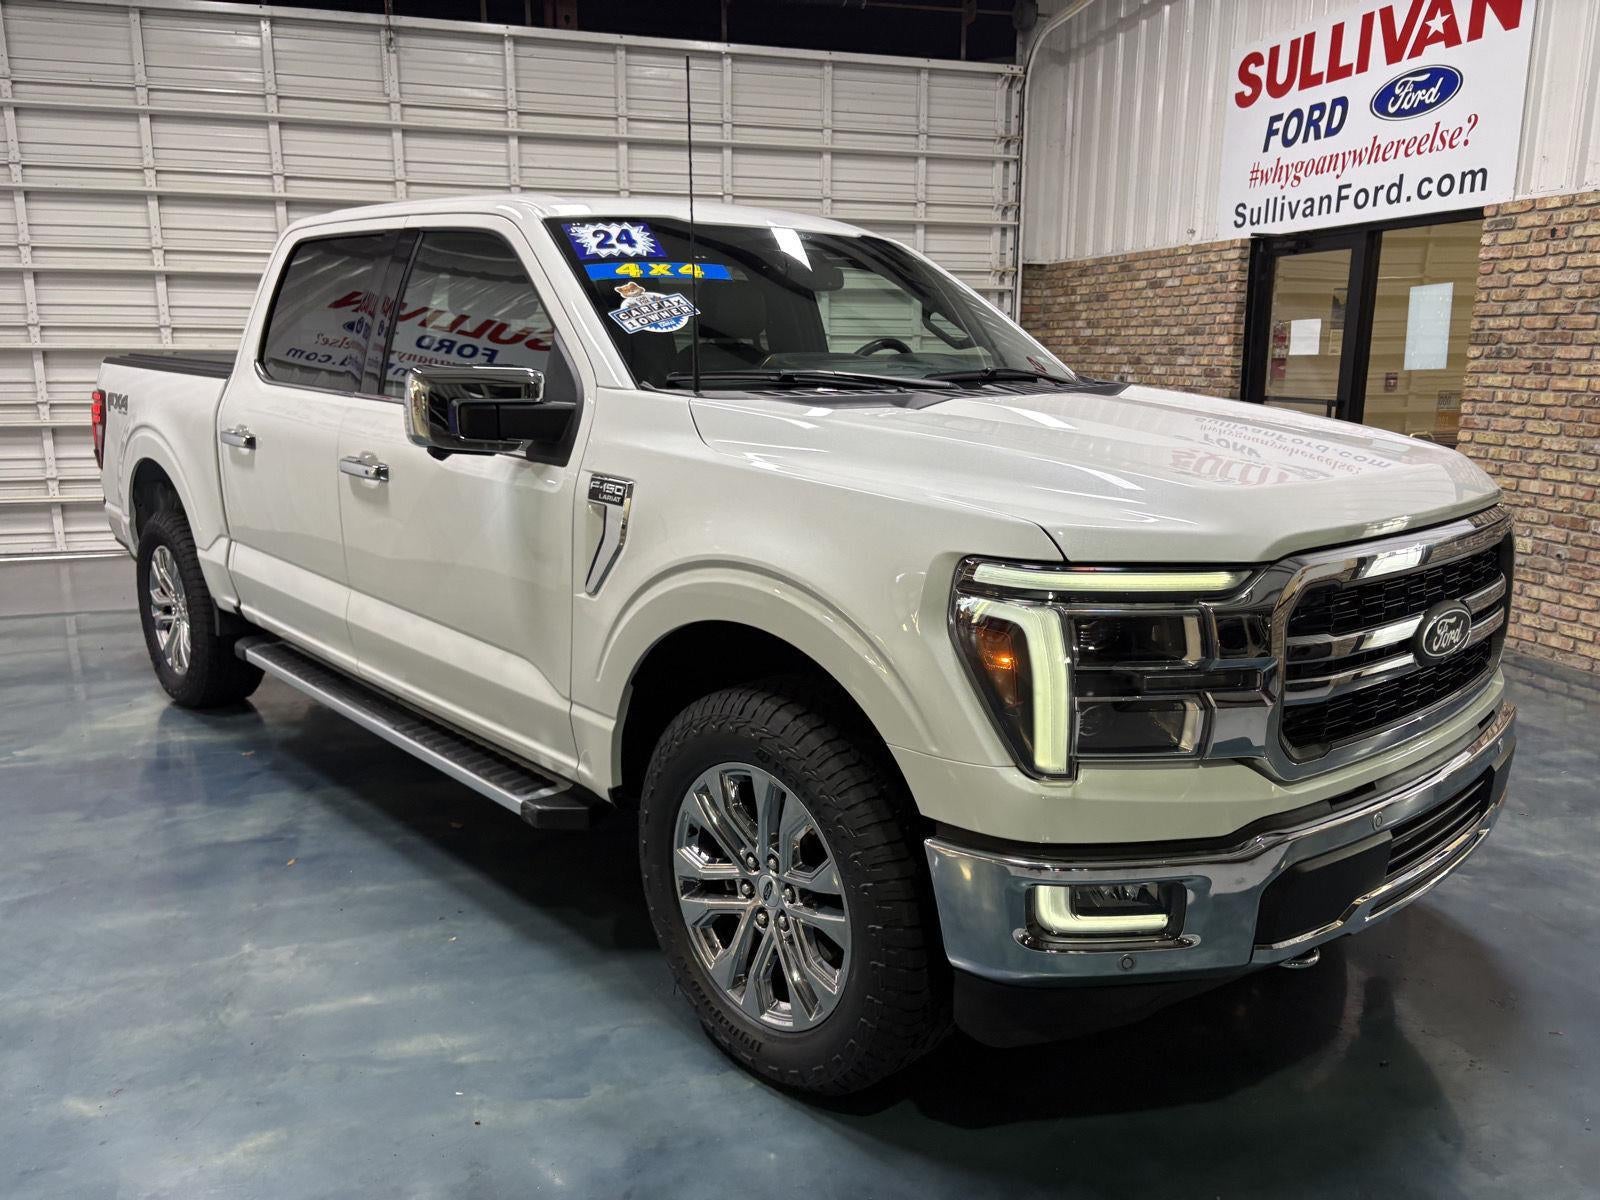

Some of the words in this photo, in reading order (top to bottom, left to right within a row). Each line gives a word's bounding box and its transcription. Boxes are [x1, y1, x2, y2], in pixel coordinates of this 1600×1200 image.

[1234, 0, 1522, 108] SULLIVAN
[1388, 73, 1442, 114] Ford
[1262, 96, 1348, 153] FORD
[1248, 113, 1478, 190] #whygoanywhereelse?
[1233, 167, 1488, 229] SullivanFord.com
[592, 228, 637, 250] 24
[617, 298, 685, 321] CARFAX
[638, 305, 692, 325] OWNER
[598, 493, 622, 503] LARIAT
[1432, 615, 1464, 651] Ford
